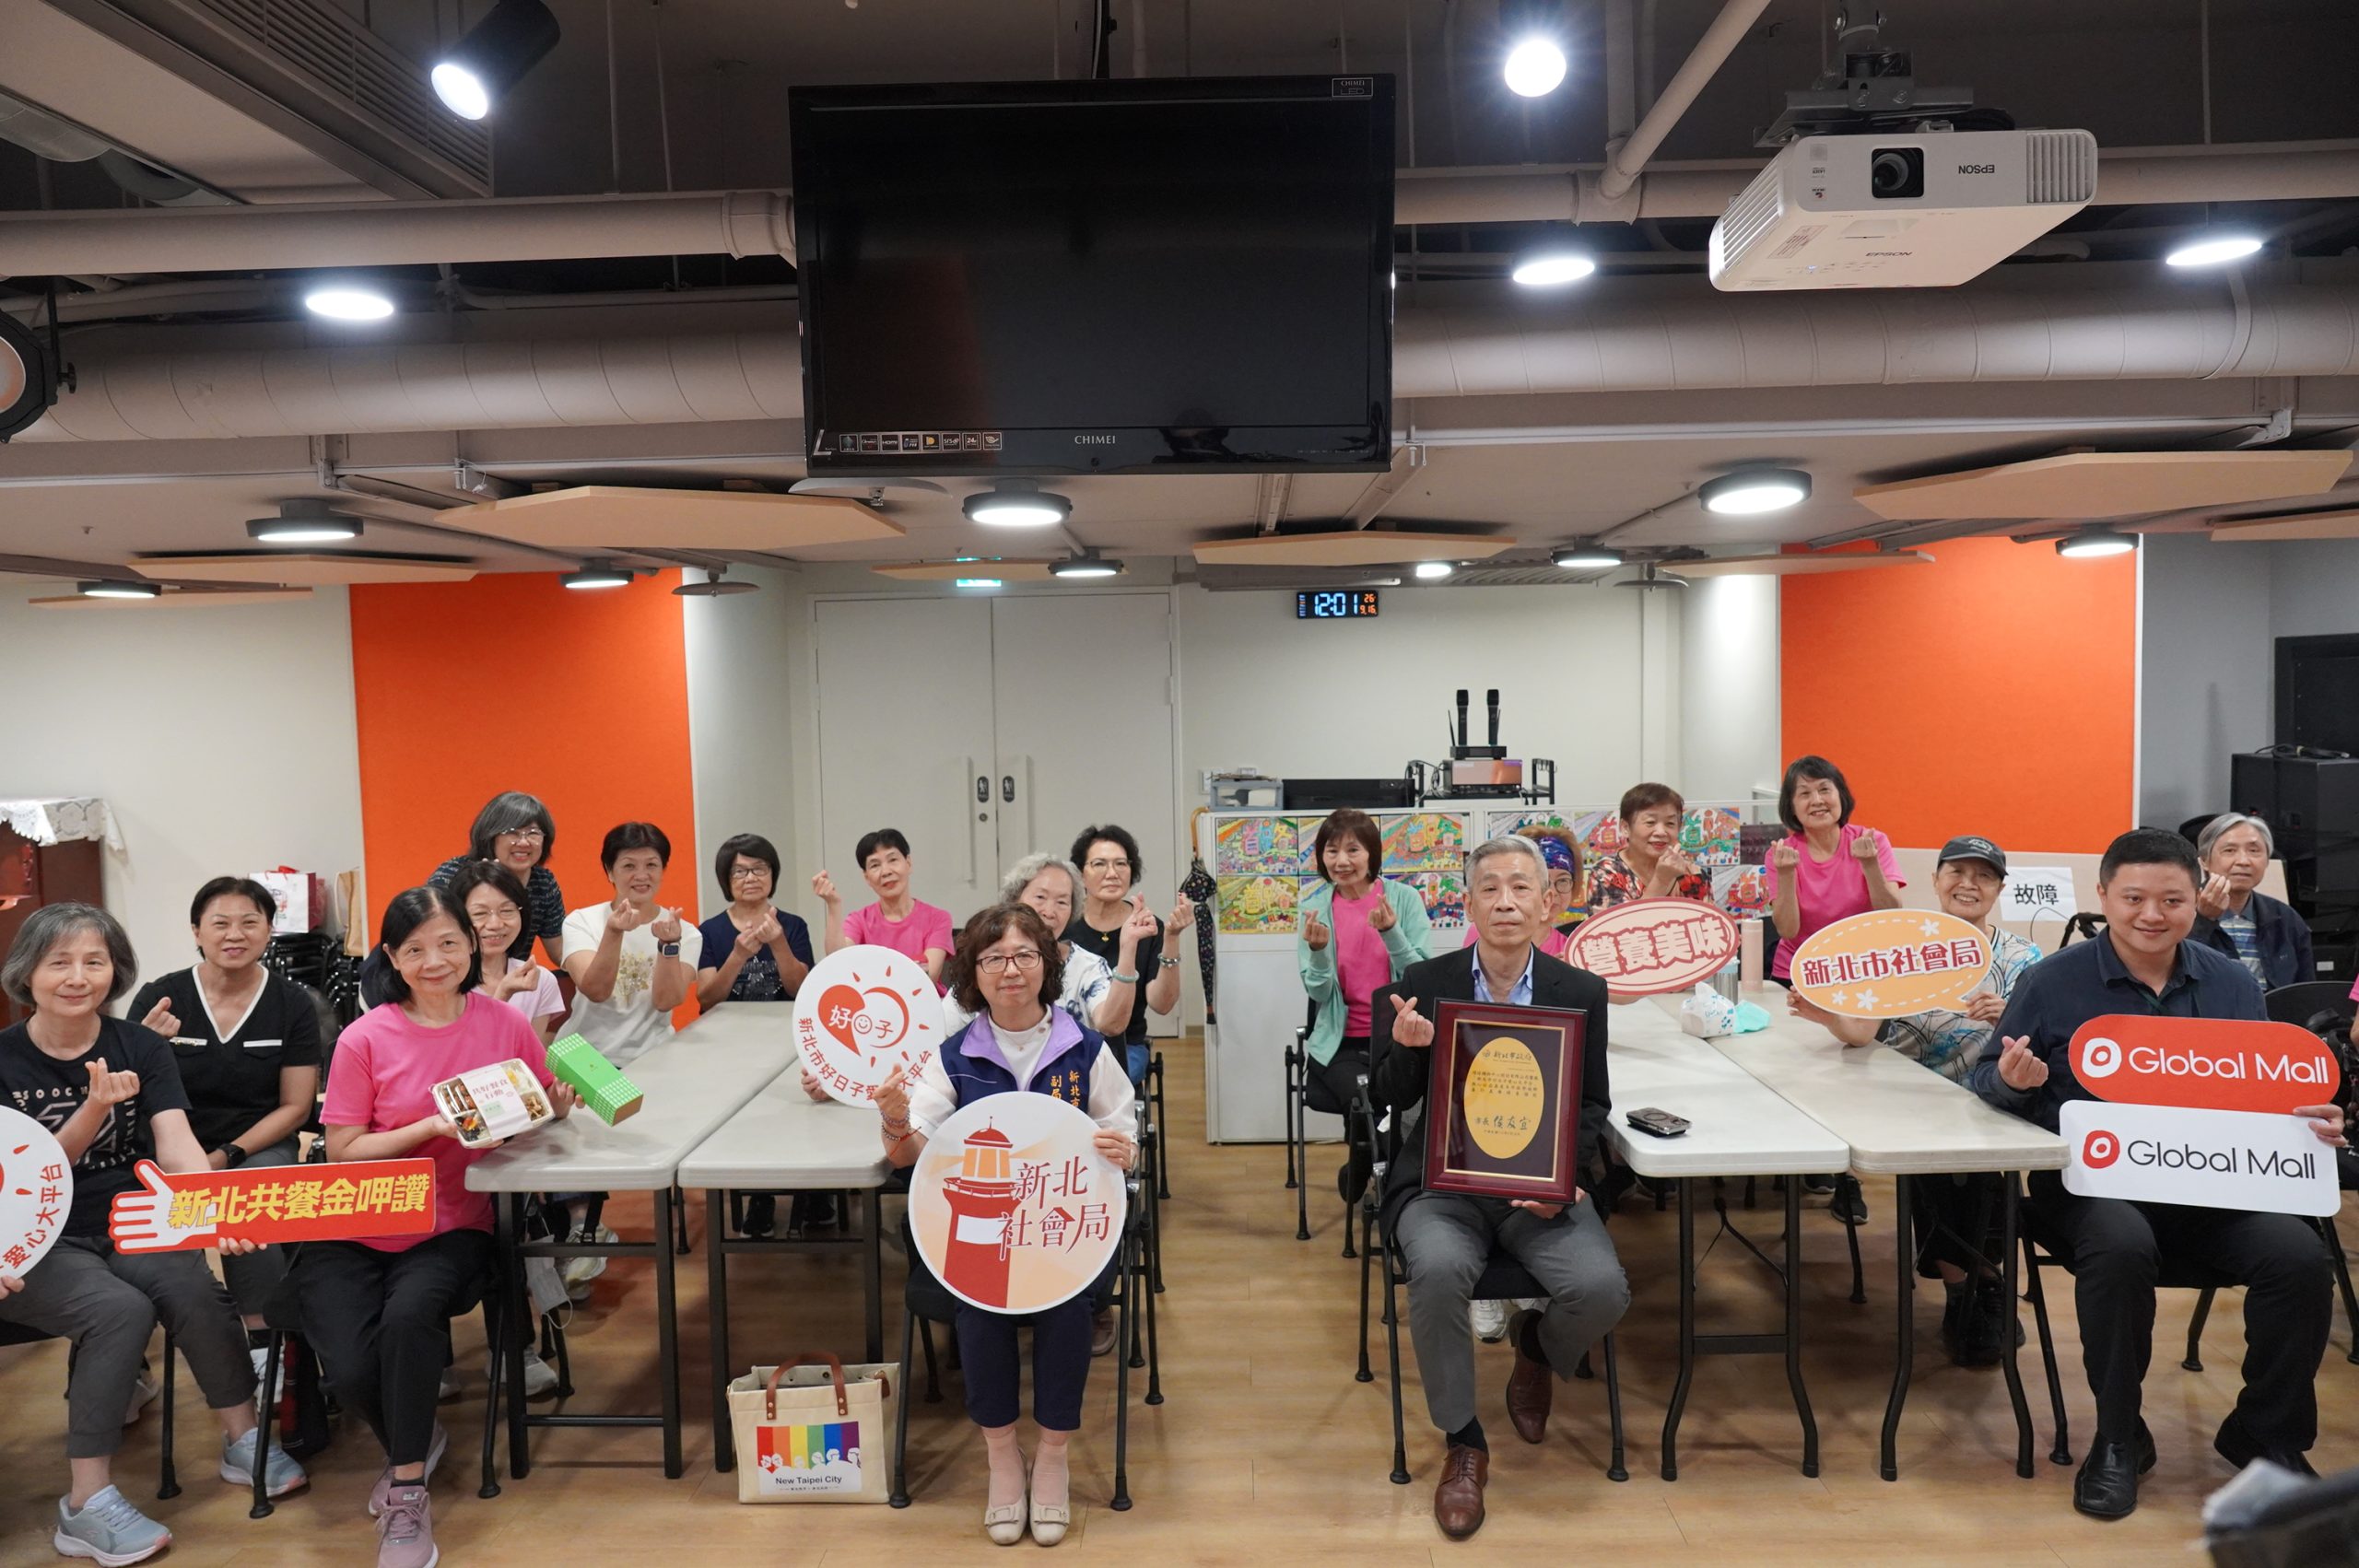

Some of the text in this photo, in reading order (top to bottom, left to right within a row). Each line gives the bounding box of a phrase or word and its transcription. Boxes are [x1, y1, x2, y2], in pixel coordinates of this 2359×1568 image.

[1958, 164, 1995, 174] EPSON
[1074, 435, 1116, 445] CHIMEI
[1314, 592, 1358, 616] 12:01
[2013, 883, 2059, 906] 故障
[1580, 917, 1729, 973] 營養美味
[1802, 939, 1982, 987] 新北市社會局
[798, 1016, 933, 1101] 新北市好日子愛大平台
[2128, 1046, 2330, 1084] Global Mall
[2127, 1140, 2316, 1179] Global Mall
[168, 1172, 431, 1230] 新北共餐金呷讚
[1013, 1155, 1089, 1210] 新北
[0, 1164, 64, 1270] 愛心大平台
[995, 1202, 1110, 1262] 社會局
[775, 1474, 842, 1485] New Taipei City
